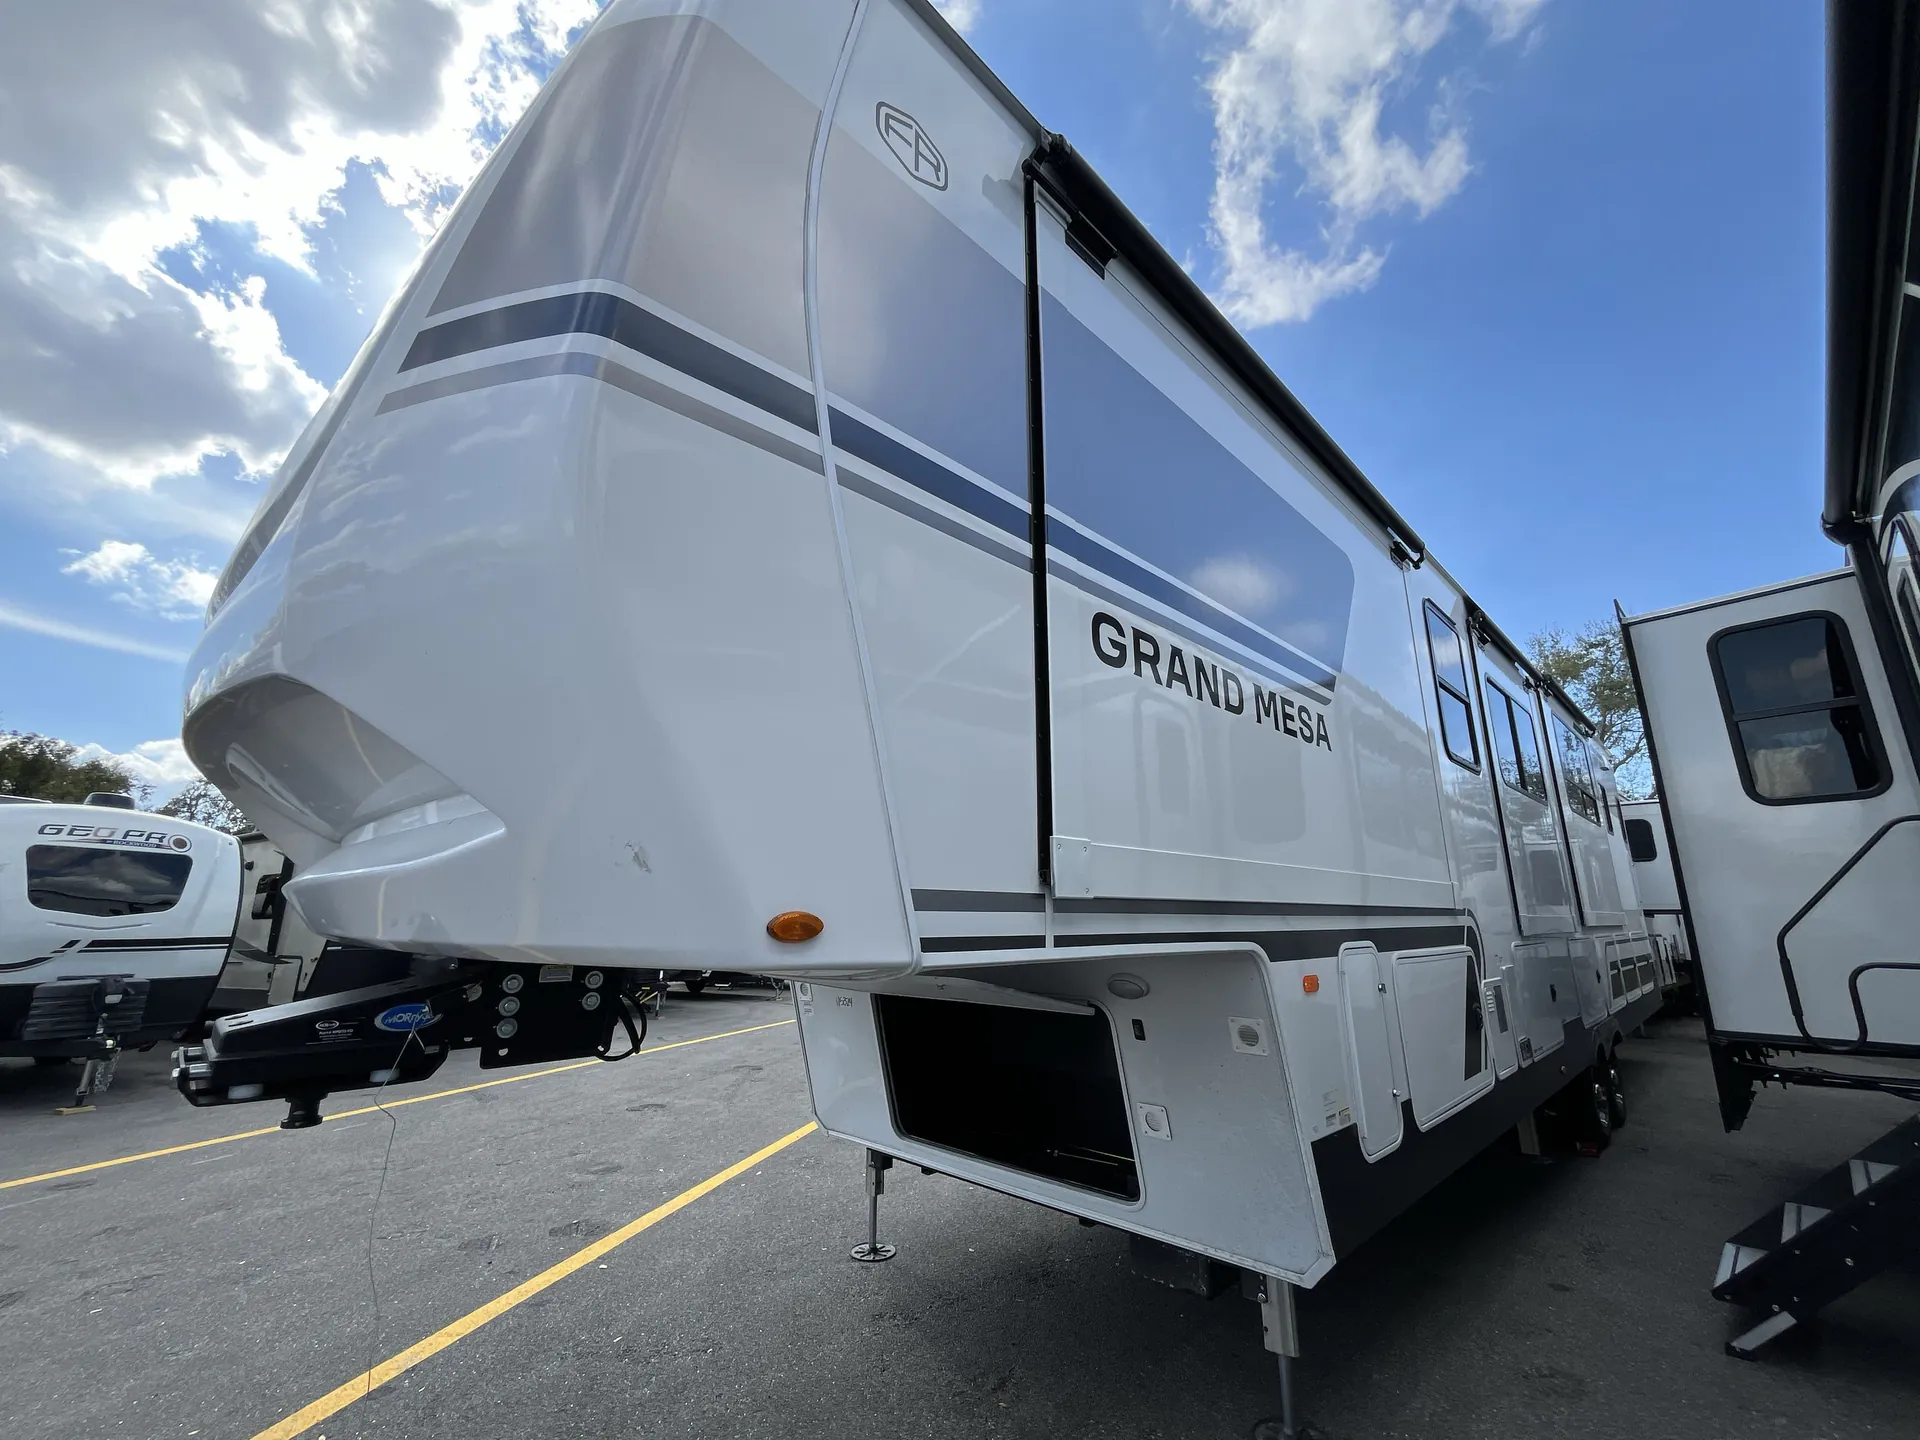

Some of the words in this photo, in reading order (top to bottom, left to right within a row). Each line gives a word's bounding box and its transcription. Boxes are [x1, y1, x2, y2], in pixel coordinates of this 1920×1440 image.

[1091, 611, 1245, 716] GRAND
[1252, 682, 1332, 752] MESA
[38, 824, 118, 838] GEO
[122, 829, 192, 853] PRO
